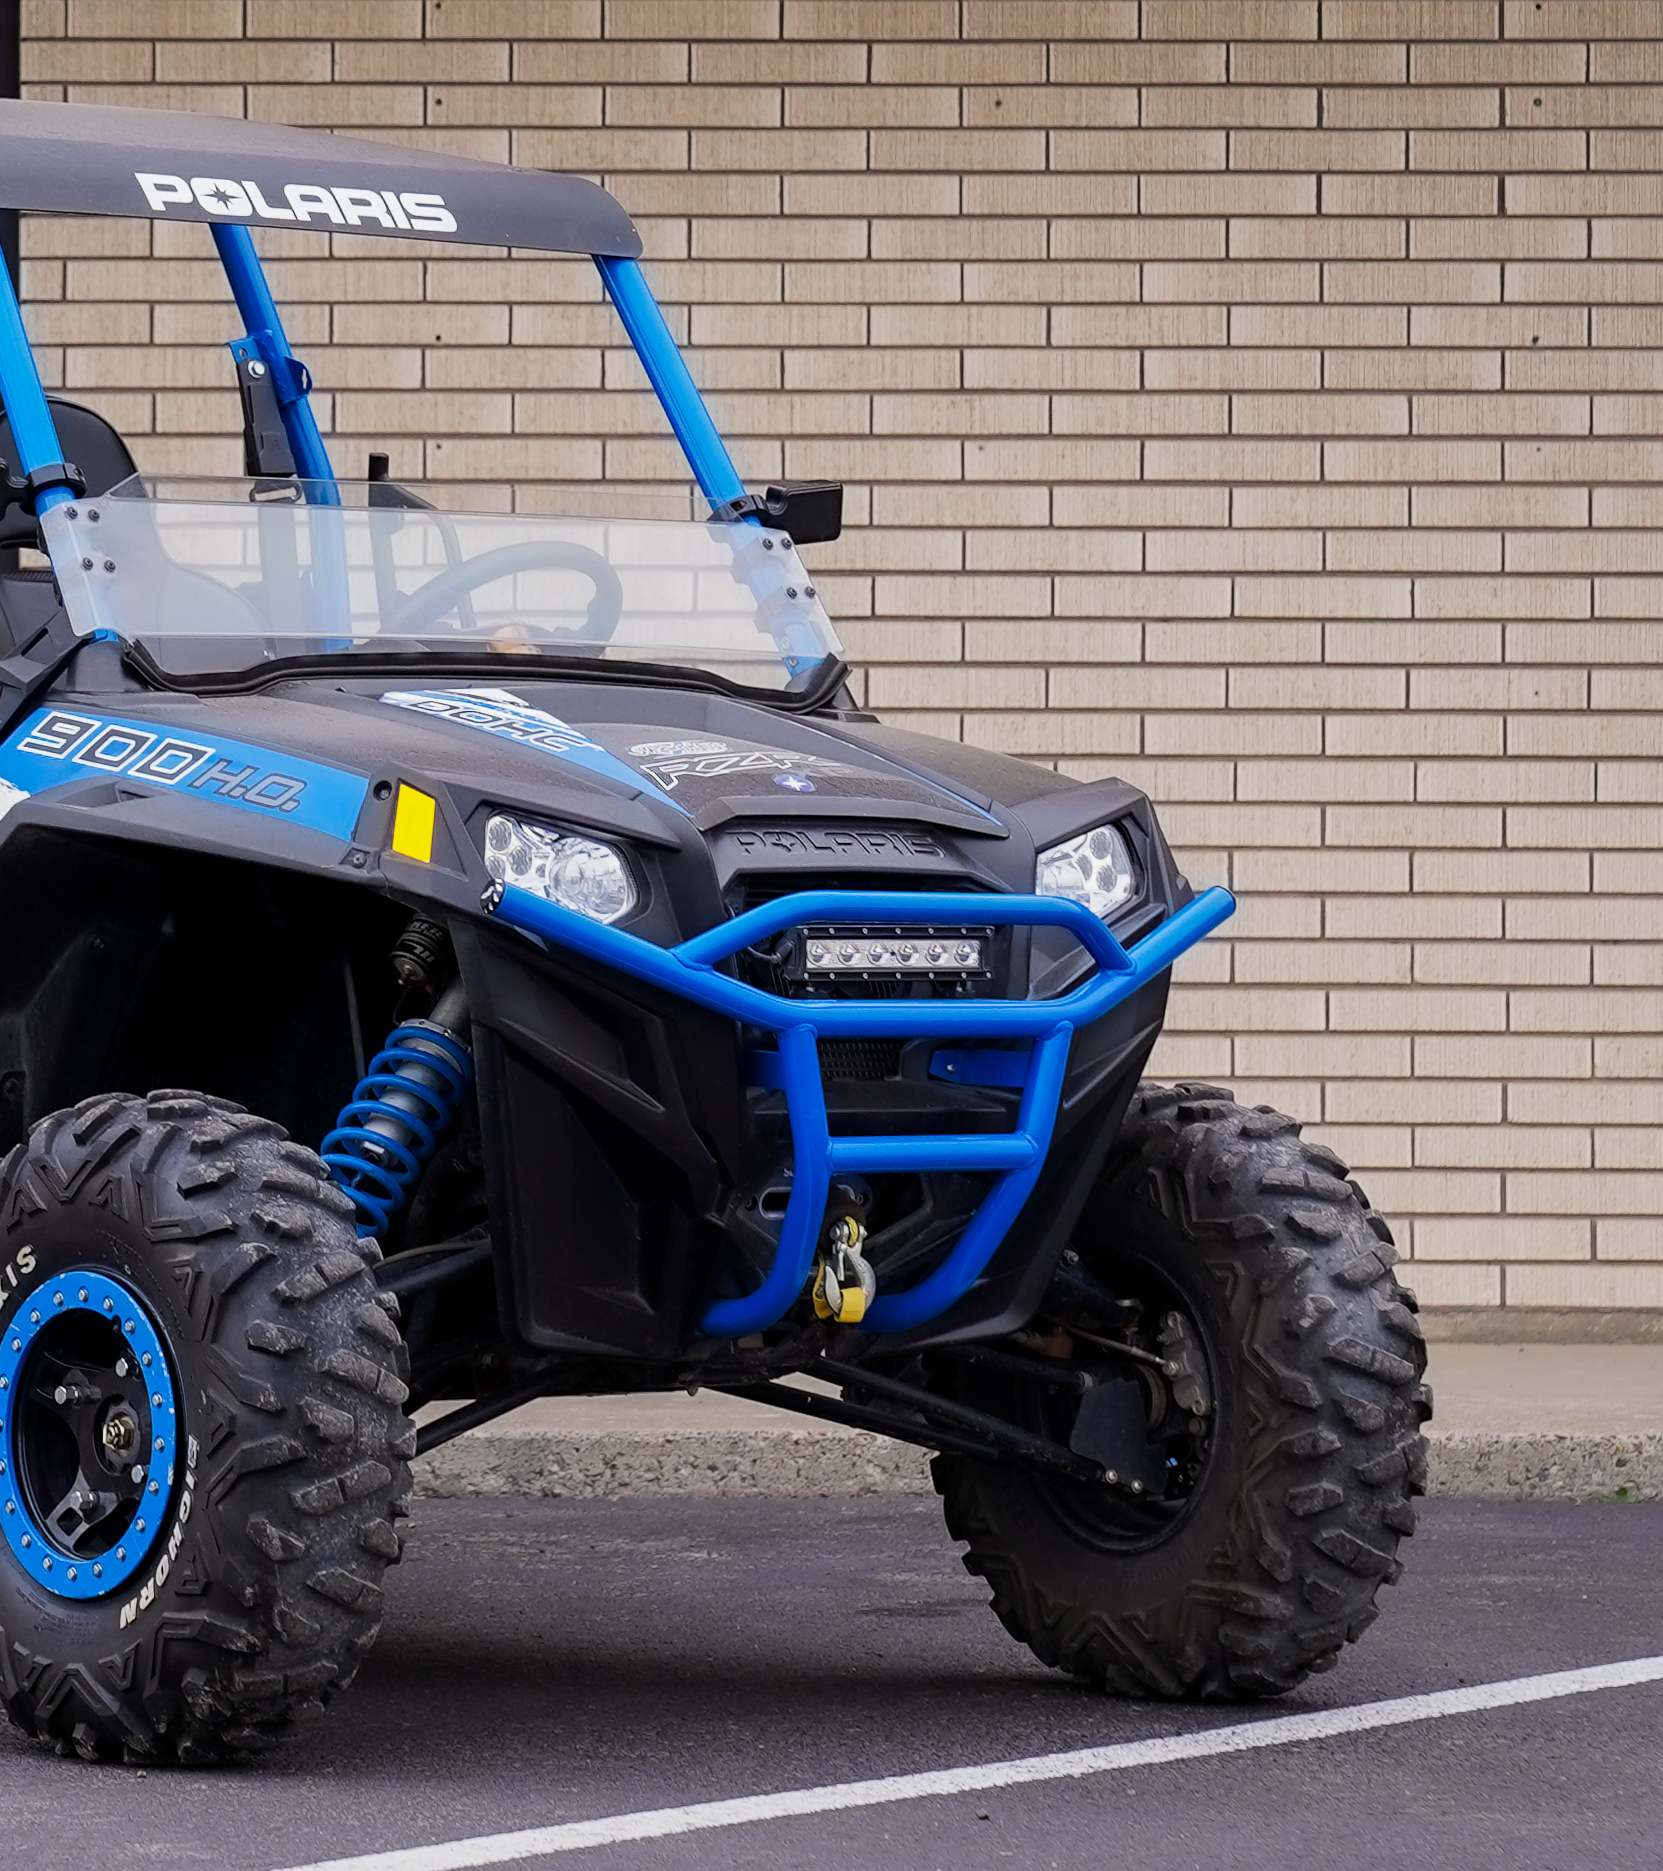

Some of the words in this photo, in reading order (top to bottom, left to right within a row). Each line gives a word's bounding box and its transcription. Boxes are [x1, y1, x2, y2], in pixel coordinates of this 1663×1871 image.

[134, 172, 458, 234] POLARIS
[17, 711, 217, 786] 900
[725, 830, 946, 858] POLARIS
[120, 1434, 200, 1630] BIGHORN
